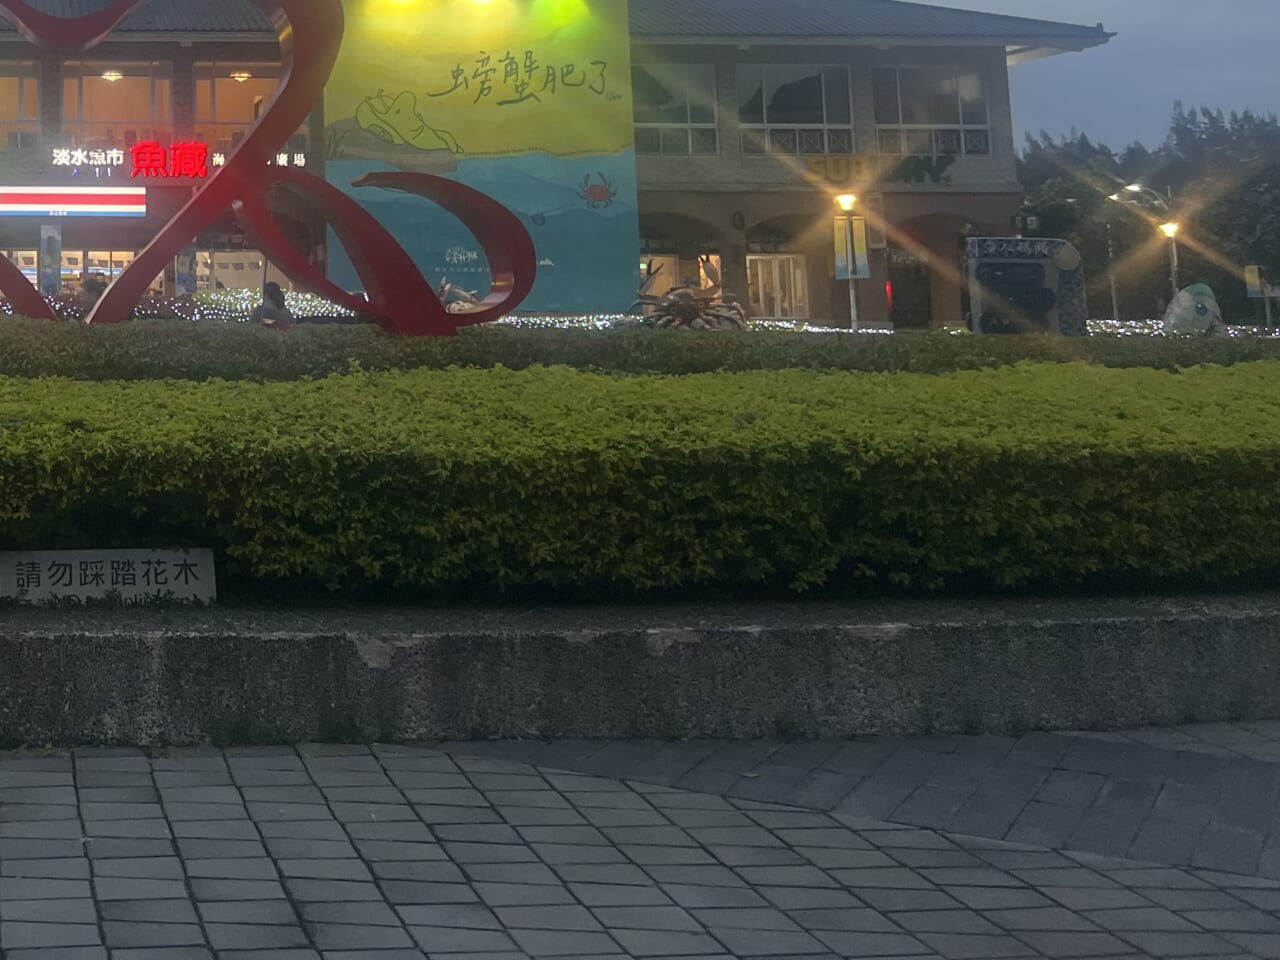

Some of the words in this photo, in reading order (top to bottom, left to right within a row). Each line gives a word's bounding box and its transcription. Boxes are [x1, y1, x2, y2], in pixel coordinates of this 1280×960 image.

[425, 50, 608, 107] 螃蟹肥了
[52, 149, 124, 166] 淡水魚市
[130, 140, 208, 178] 魚藏
[15, 558, 200, 588] 請勿踩踏花木
